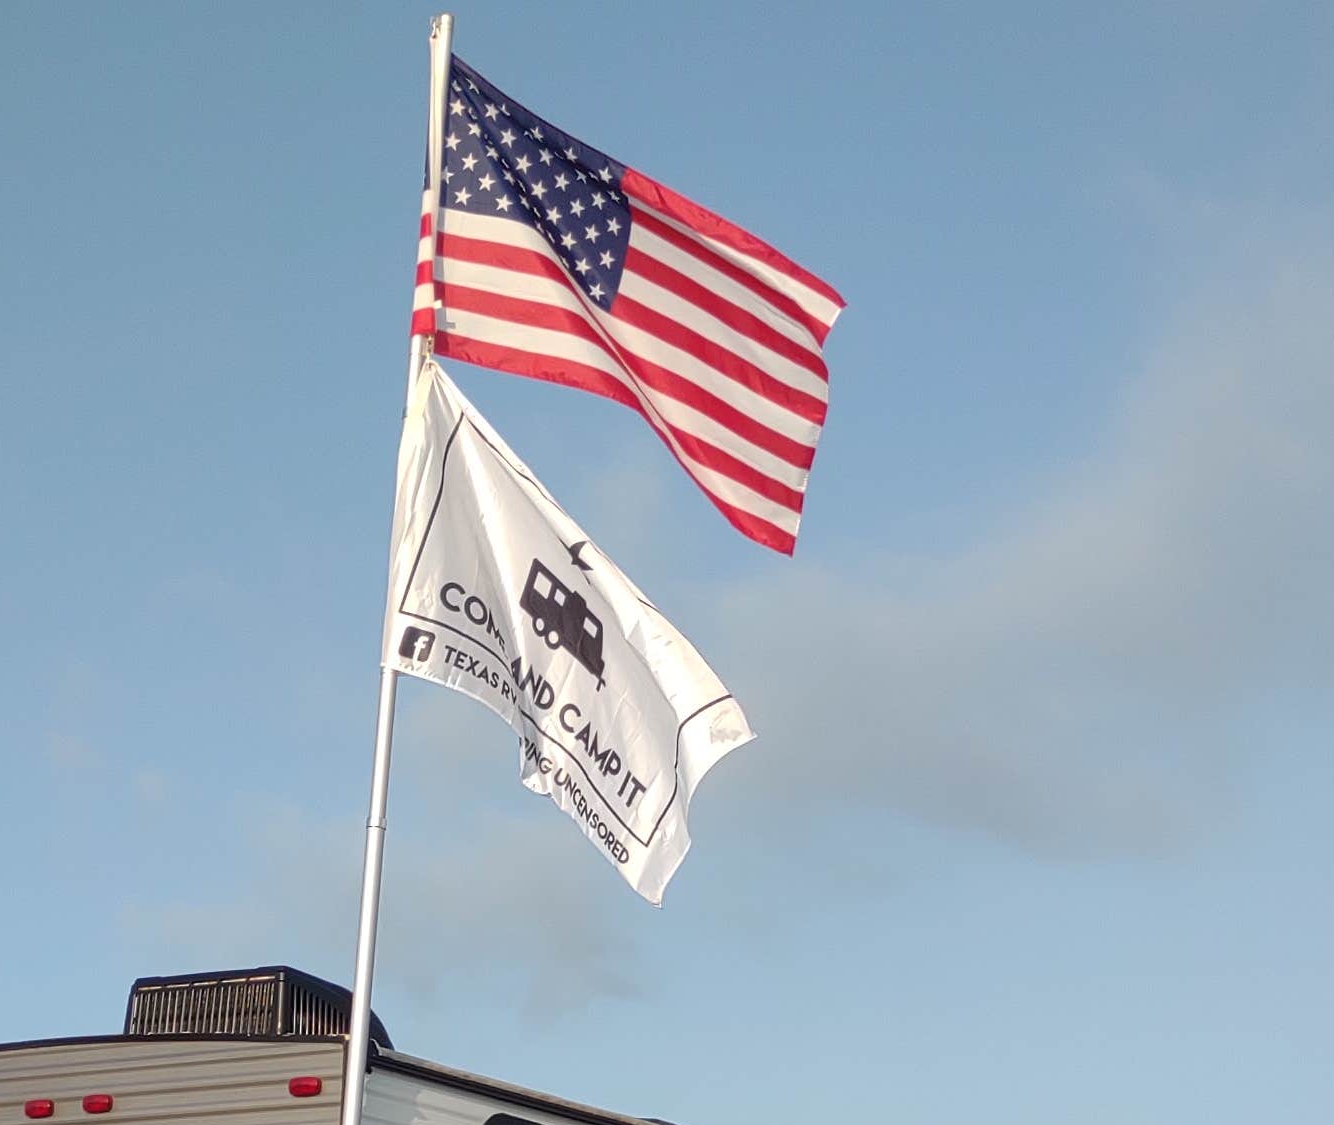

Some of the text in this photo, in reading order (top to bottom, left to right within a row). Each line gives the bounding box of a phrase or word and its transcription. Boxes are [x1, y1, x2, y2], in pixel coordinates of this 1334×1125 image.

[440, 582, 647, 807] COM AND CAMP IT
[444, 645, 500, 689] TEXAS
[553, 768, 630, 864] UNCENSORED
